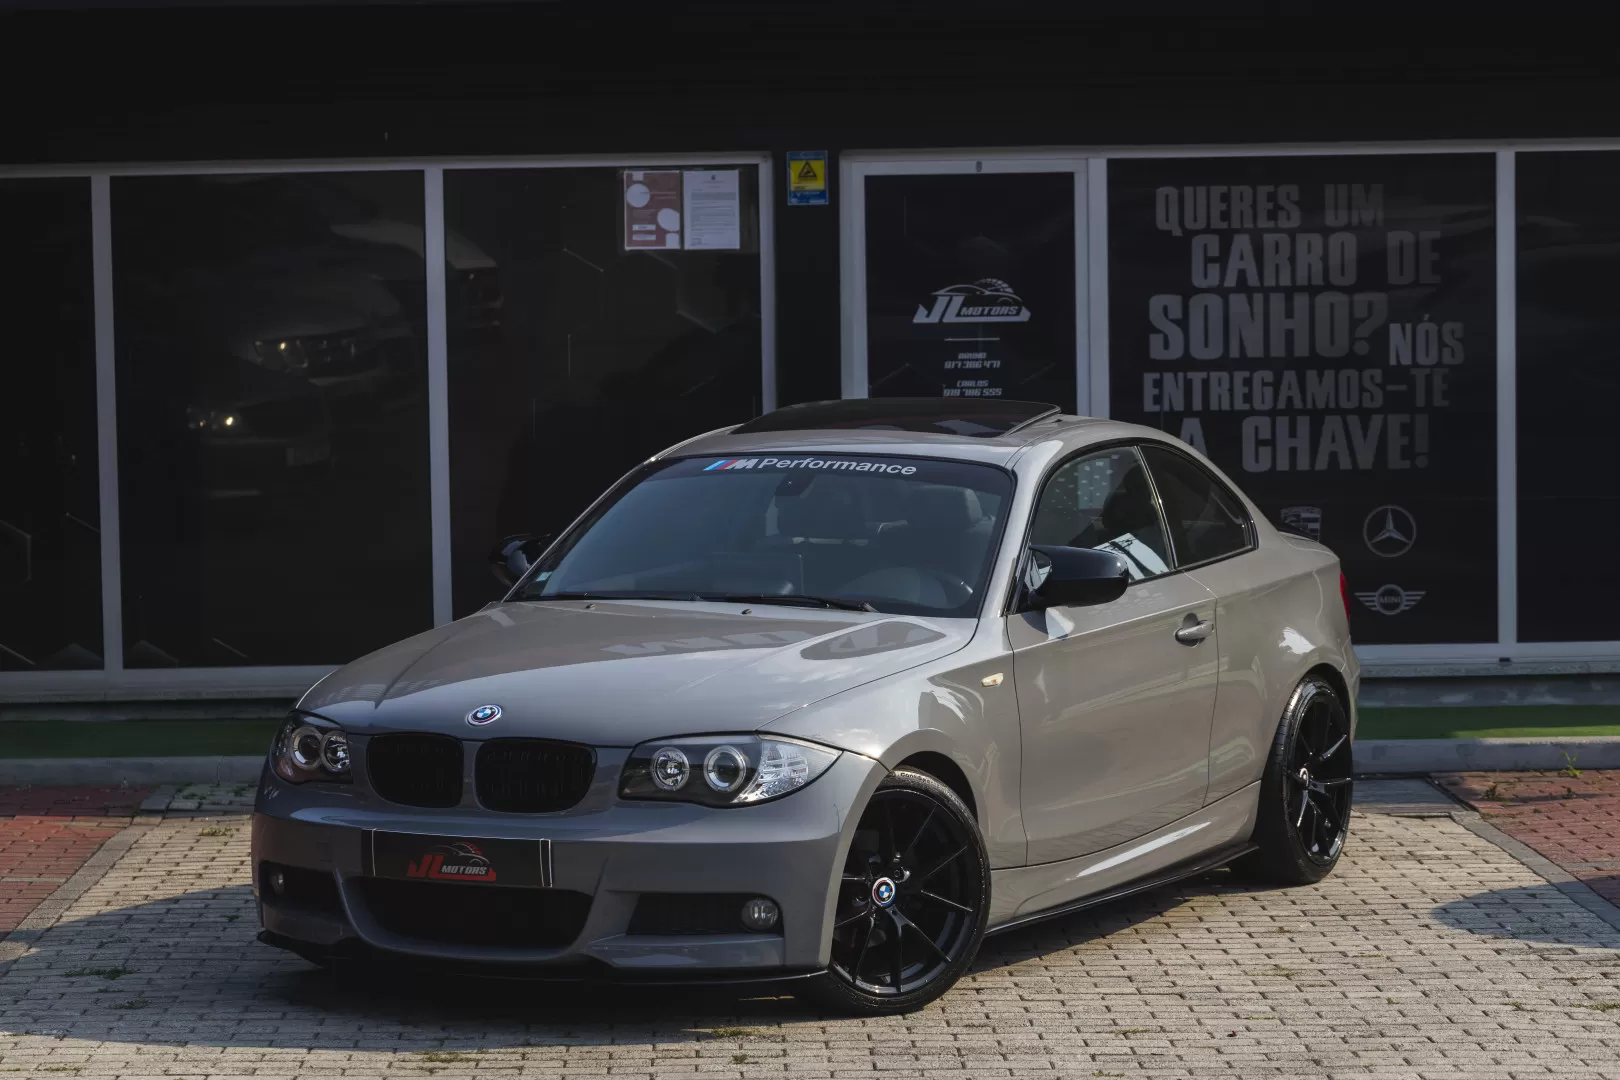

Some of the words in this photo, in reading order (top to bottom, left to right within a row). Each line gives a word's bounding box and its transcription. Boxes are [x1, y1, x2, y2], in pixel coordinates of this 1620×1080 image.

[1155, 184, 1301, 236] QUERES
[1324, 183, 1384, 227] UM
[1191, 231, 1357, 288] CARRO
[1386, 230, 1441, 285] DE
[960, 306, 1018, 317] MOTORS
[1149, 291, 1388, 360] SONHO?
[1389, 313, 1465, 366] NÓS
[1143, 368, 1450, 413] ENTREGAMOS-TE
[758, 457, 917, 475] Performance
[1242, 414, 1430, 473] CHAVE!
[1380, 596, 1401, 604] MINI
[441, 865, 488, 875] MOTORS
